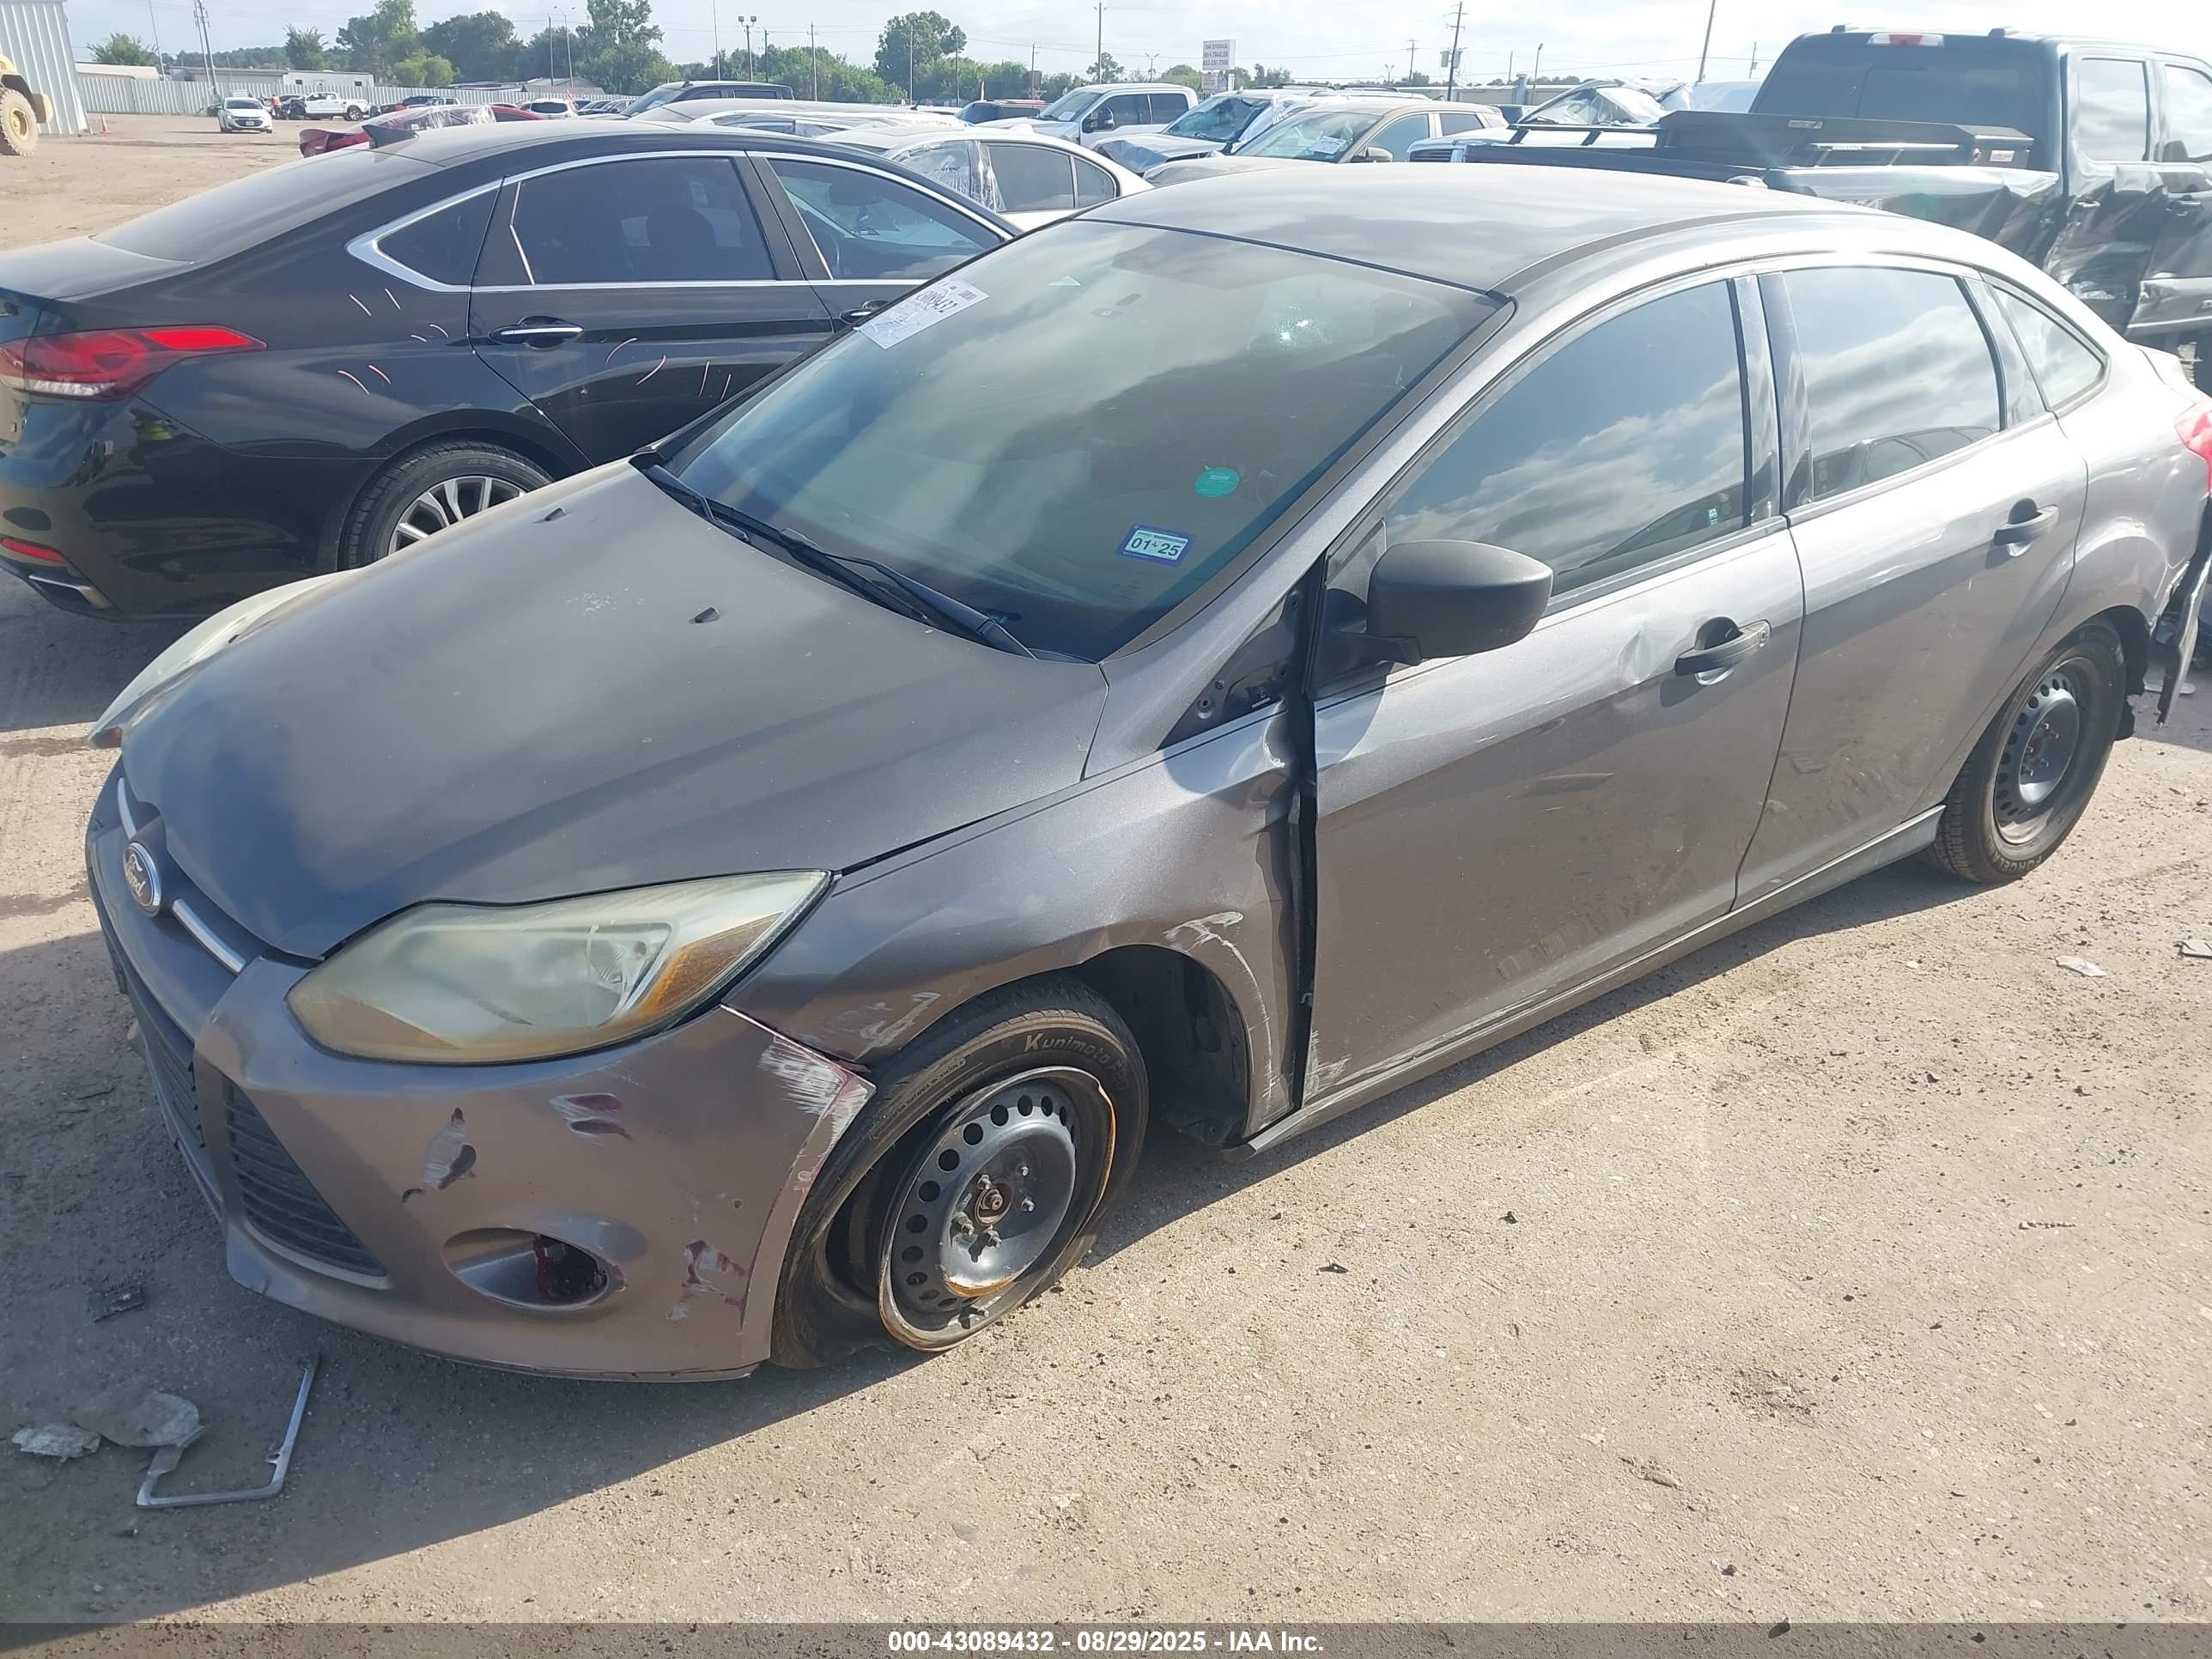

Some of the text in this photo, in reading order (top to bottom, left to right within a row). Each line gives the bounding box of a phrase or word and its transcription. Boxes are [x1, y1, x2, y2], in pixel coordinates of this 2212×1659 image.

[1158, 543, 1182, 556] 25
[123, 854, 147, 897] Ford
[1024, 1031, 1112, 1065] Kunimoto
